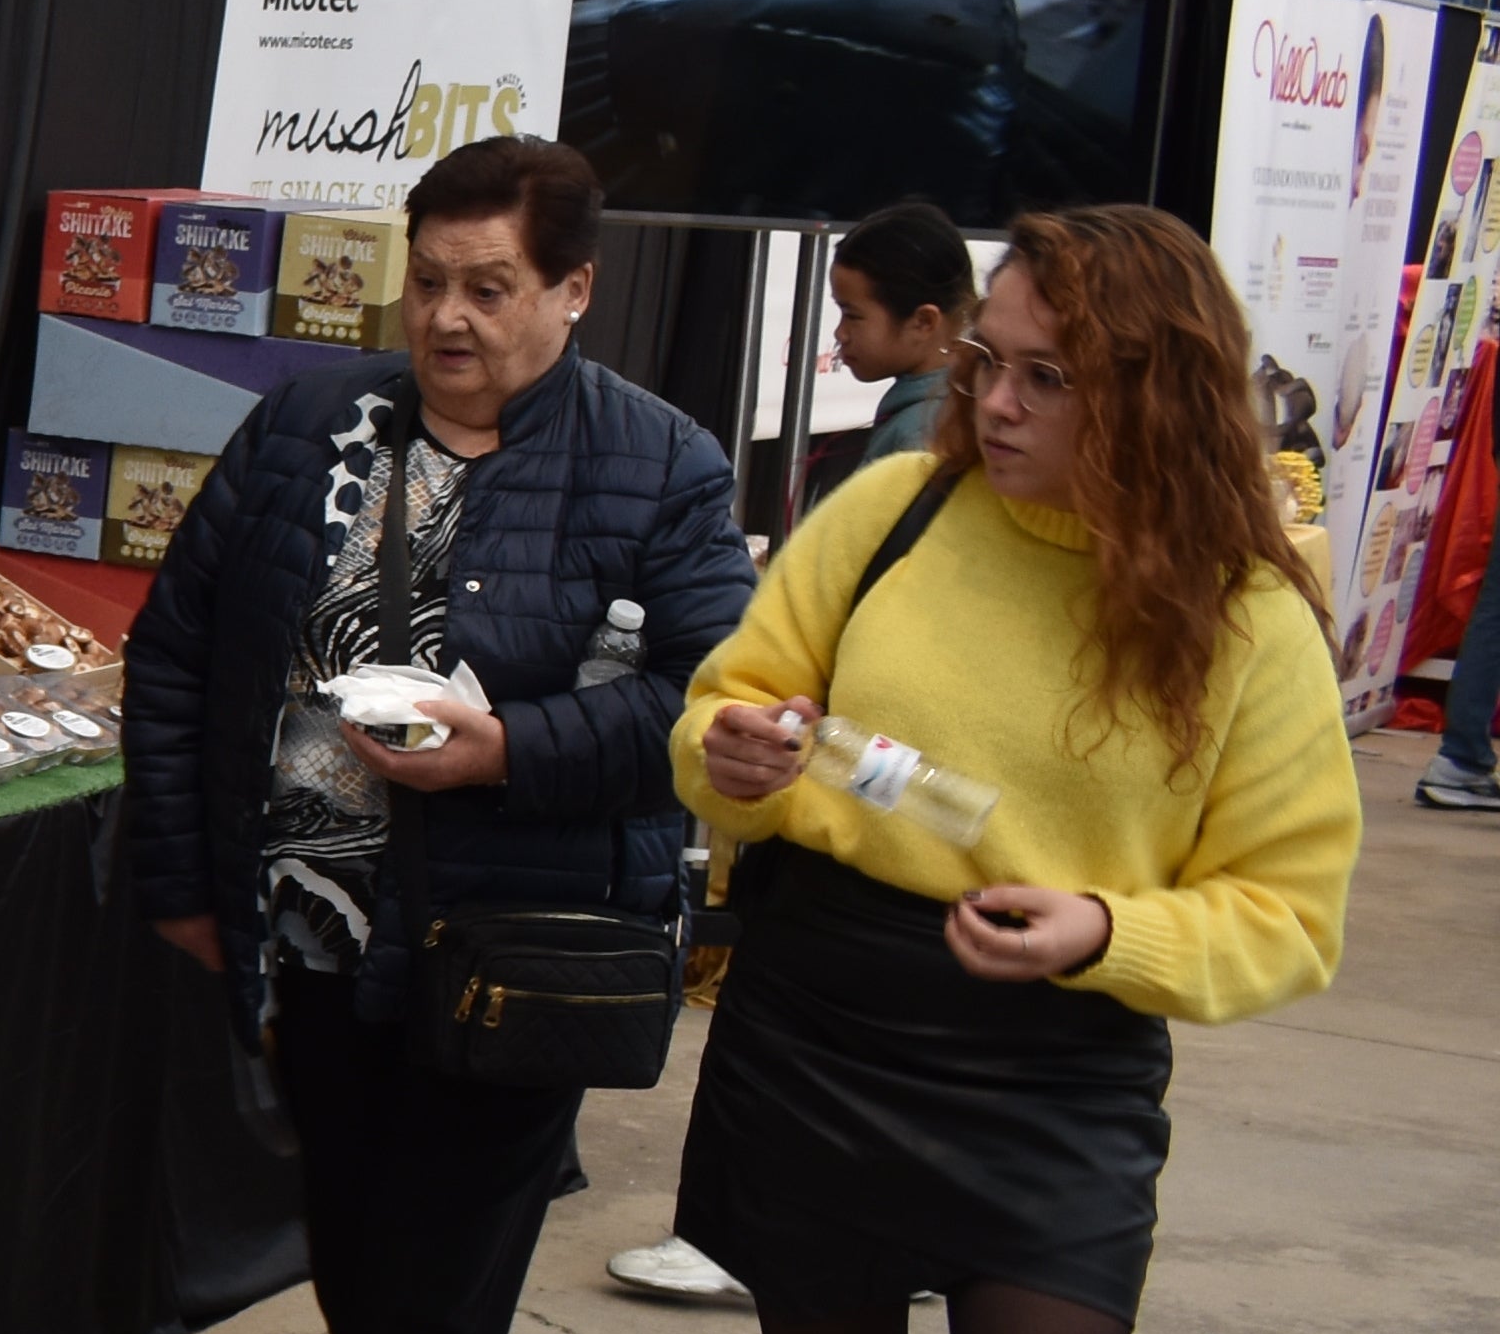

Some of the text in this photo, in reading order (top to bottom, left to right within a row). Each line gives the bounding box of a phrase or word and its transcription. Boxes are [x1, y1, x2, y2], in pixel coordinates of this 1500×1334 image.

[258, 32, 354, 51] www.micotec.es
[59, 211, 133, 239] SHIITAKE
[174, 223, 252, 252] SHIITAKE
[299, 233, 377, 263] SHIITAKE
[19, 449, 92, 479] SHIITAKE
